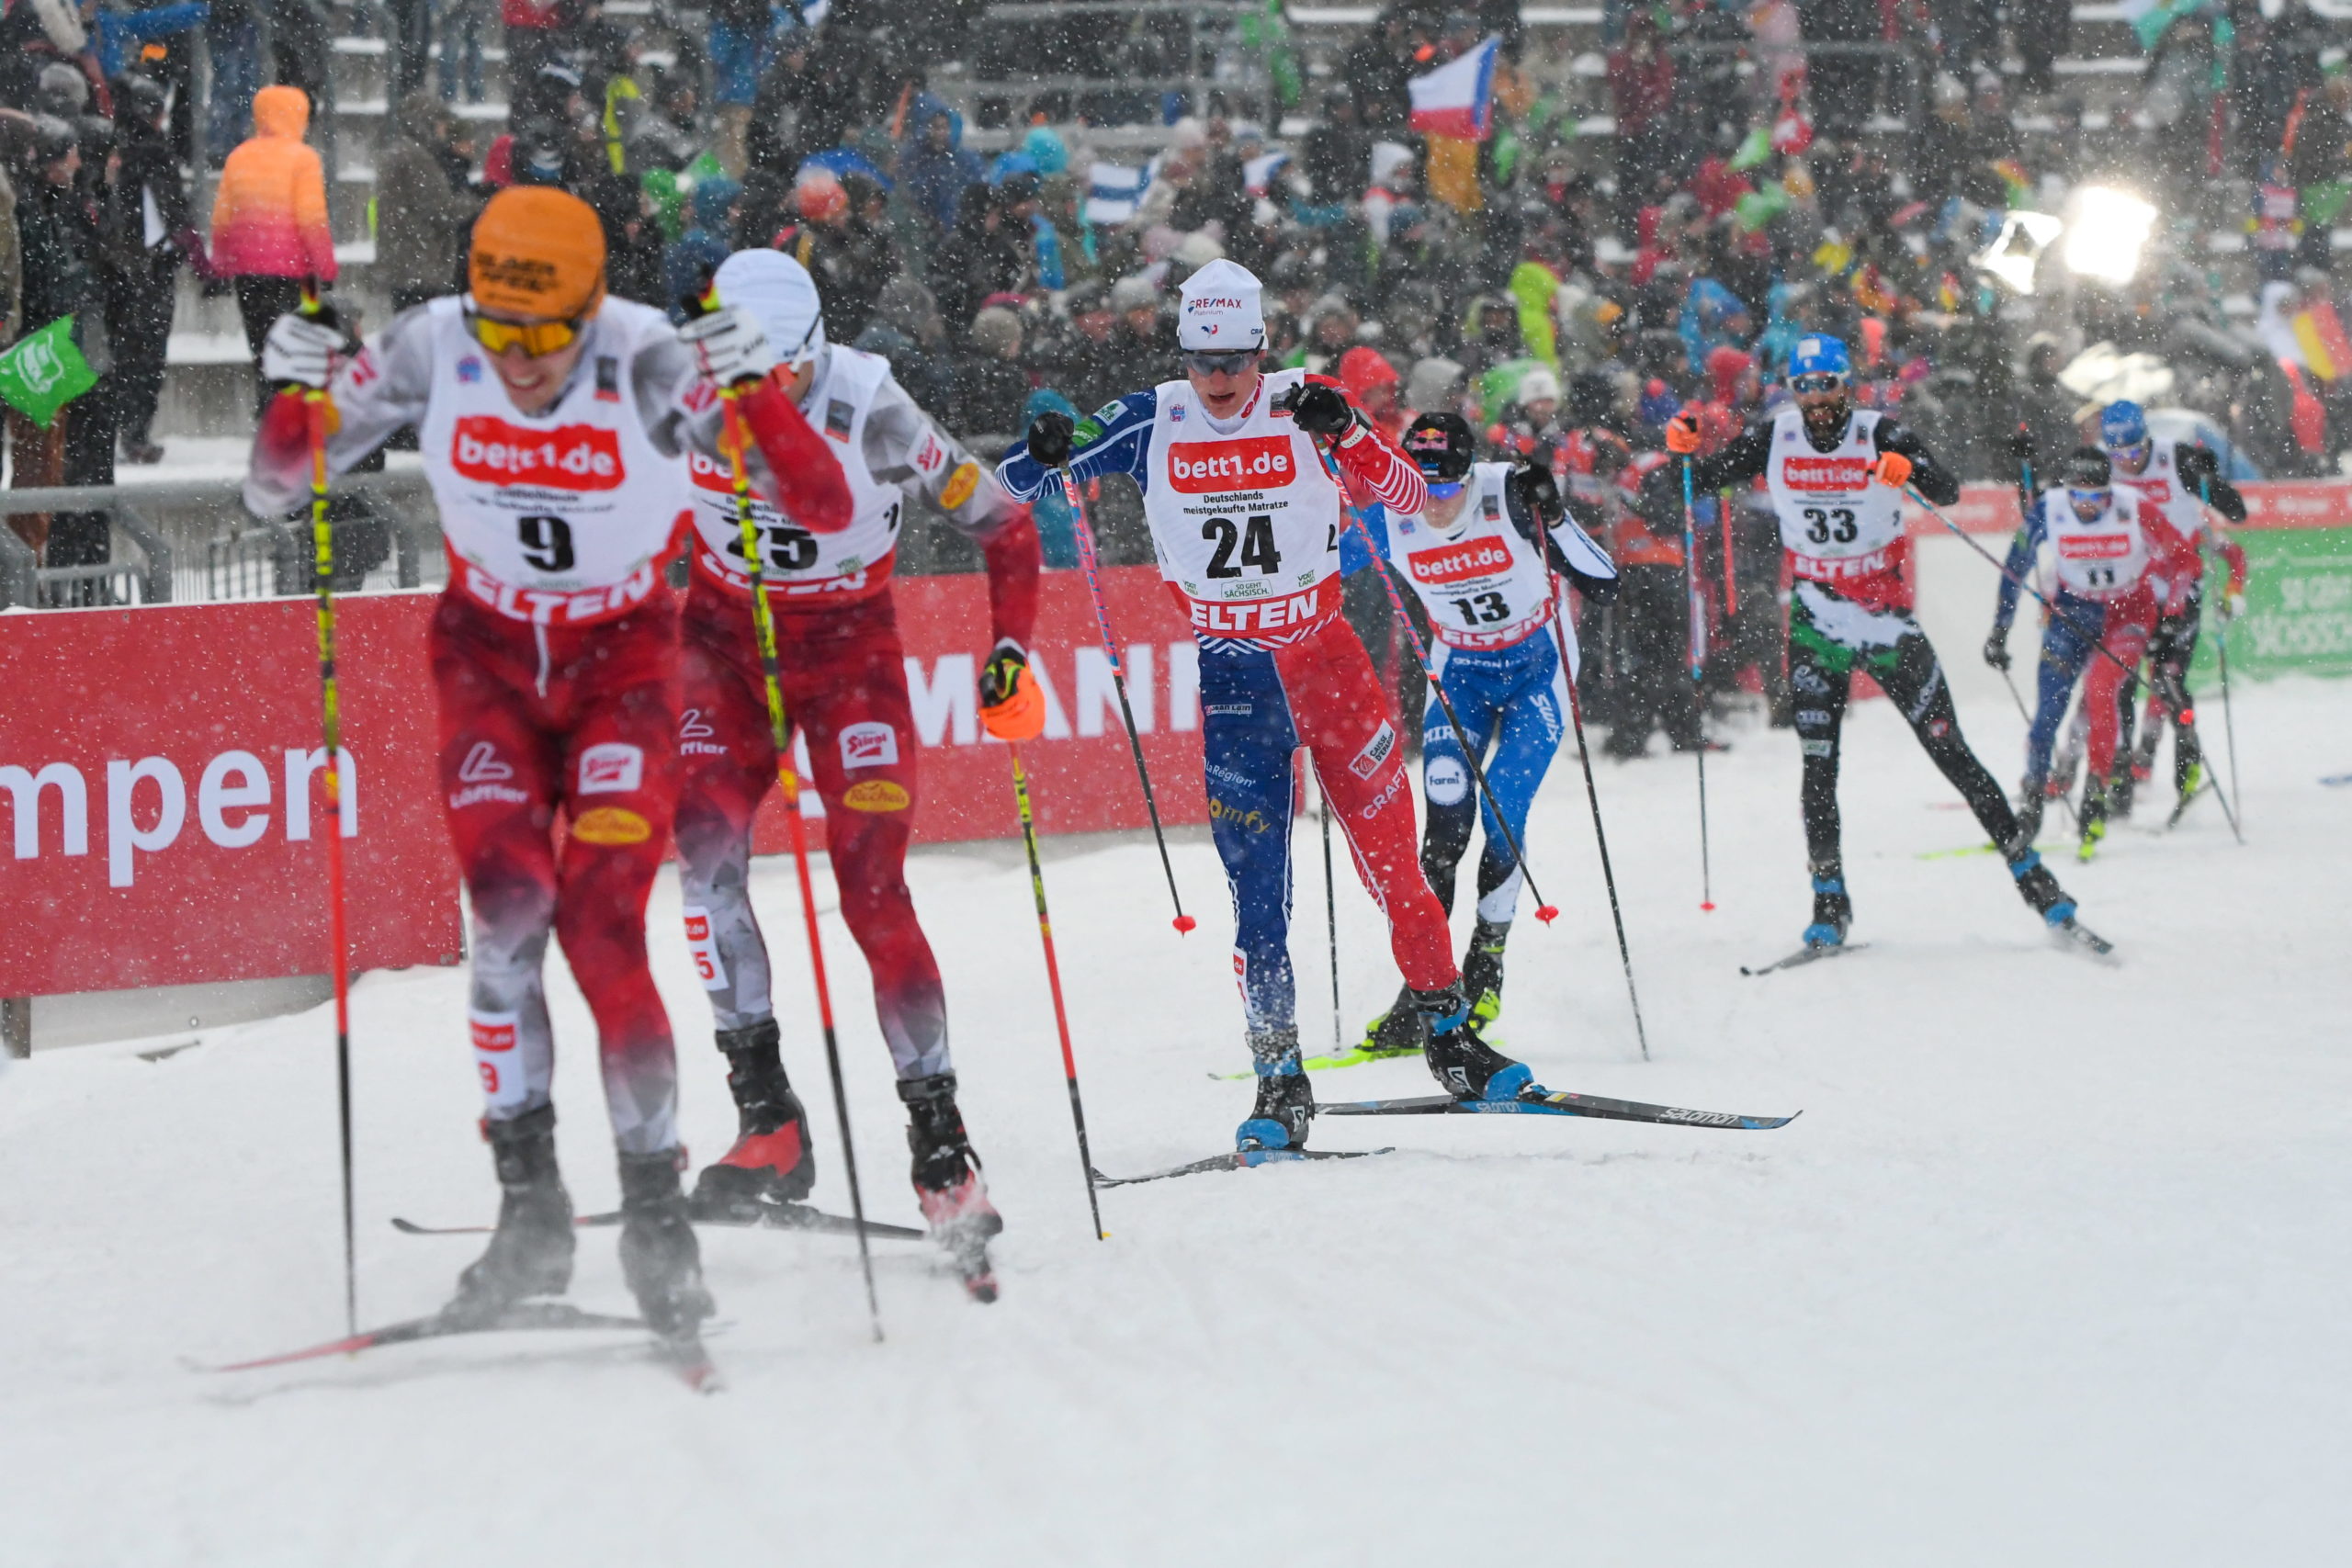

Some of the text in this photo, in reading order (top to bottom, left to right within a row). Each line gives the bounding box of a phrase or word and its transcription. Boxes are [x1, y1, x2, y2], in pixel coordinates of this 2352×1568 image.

[1195, 298, 1242, 310] RE/MAX
[1173, 451, 1288, 479] bett1.de
[1183, 500, 1289, 516] meistgekaufte Matratze
[1204, 491, 1264, 504] Deutschlands
[1803, 508, 1859, 544] 33
[517, 515, 576, 573] 9
[1201, 514, 1282, 580] 24
[1414, 547, 1508, 578] bett1.de
[1794, 551, 1886, 580] ELTEN
[465, 560, 654, 625] ELTEN
[1224, 588, 1270, 599] SÄCHSISCH.
[1245, 581, 1262, 590] GEHT
[1190, 589, 1318, 631] ELTEN
[1449, 591, 1511, 626] 13
[1442, 603, 1545, 647] ELTEN
[1370, 734, 1388, 757] CAISSE
[1205, 760, 1213, 773] La
[1212, 764, 1253, 788] Région
[1363, 762, 1406, 820] CRAFT
[0, 745, 359, 888] mpen
[1209, 797, 1272, 834] omfy
[1476, 1100, 1521, 1114] salomon
[1659, 1107, 1739, 1127] salomon
